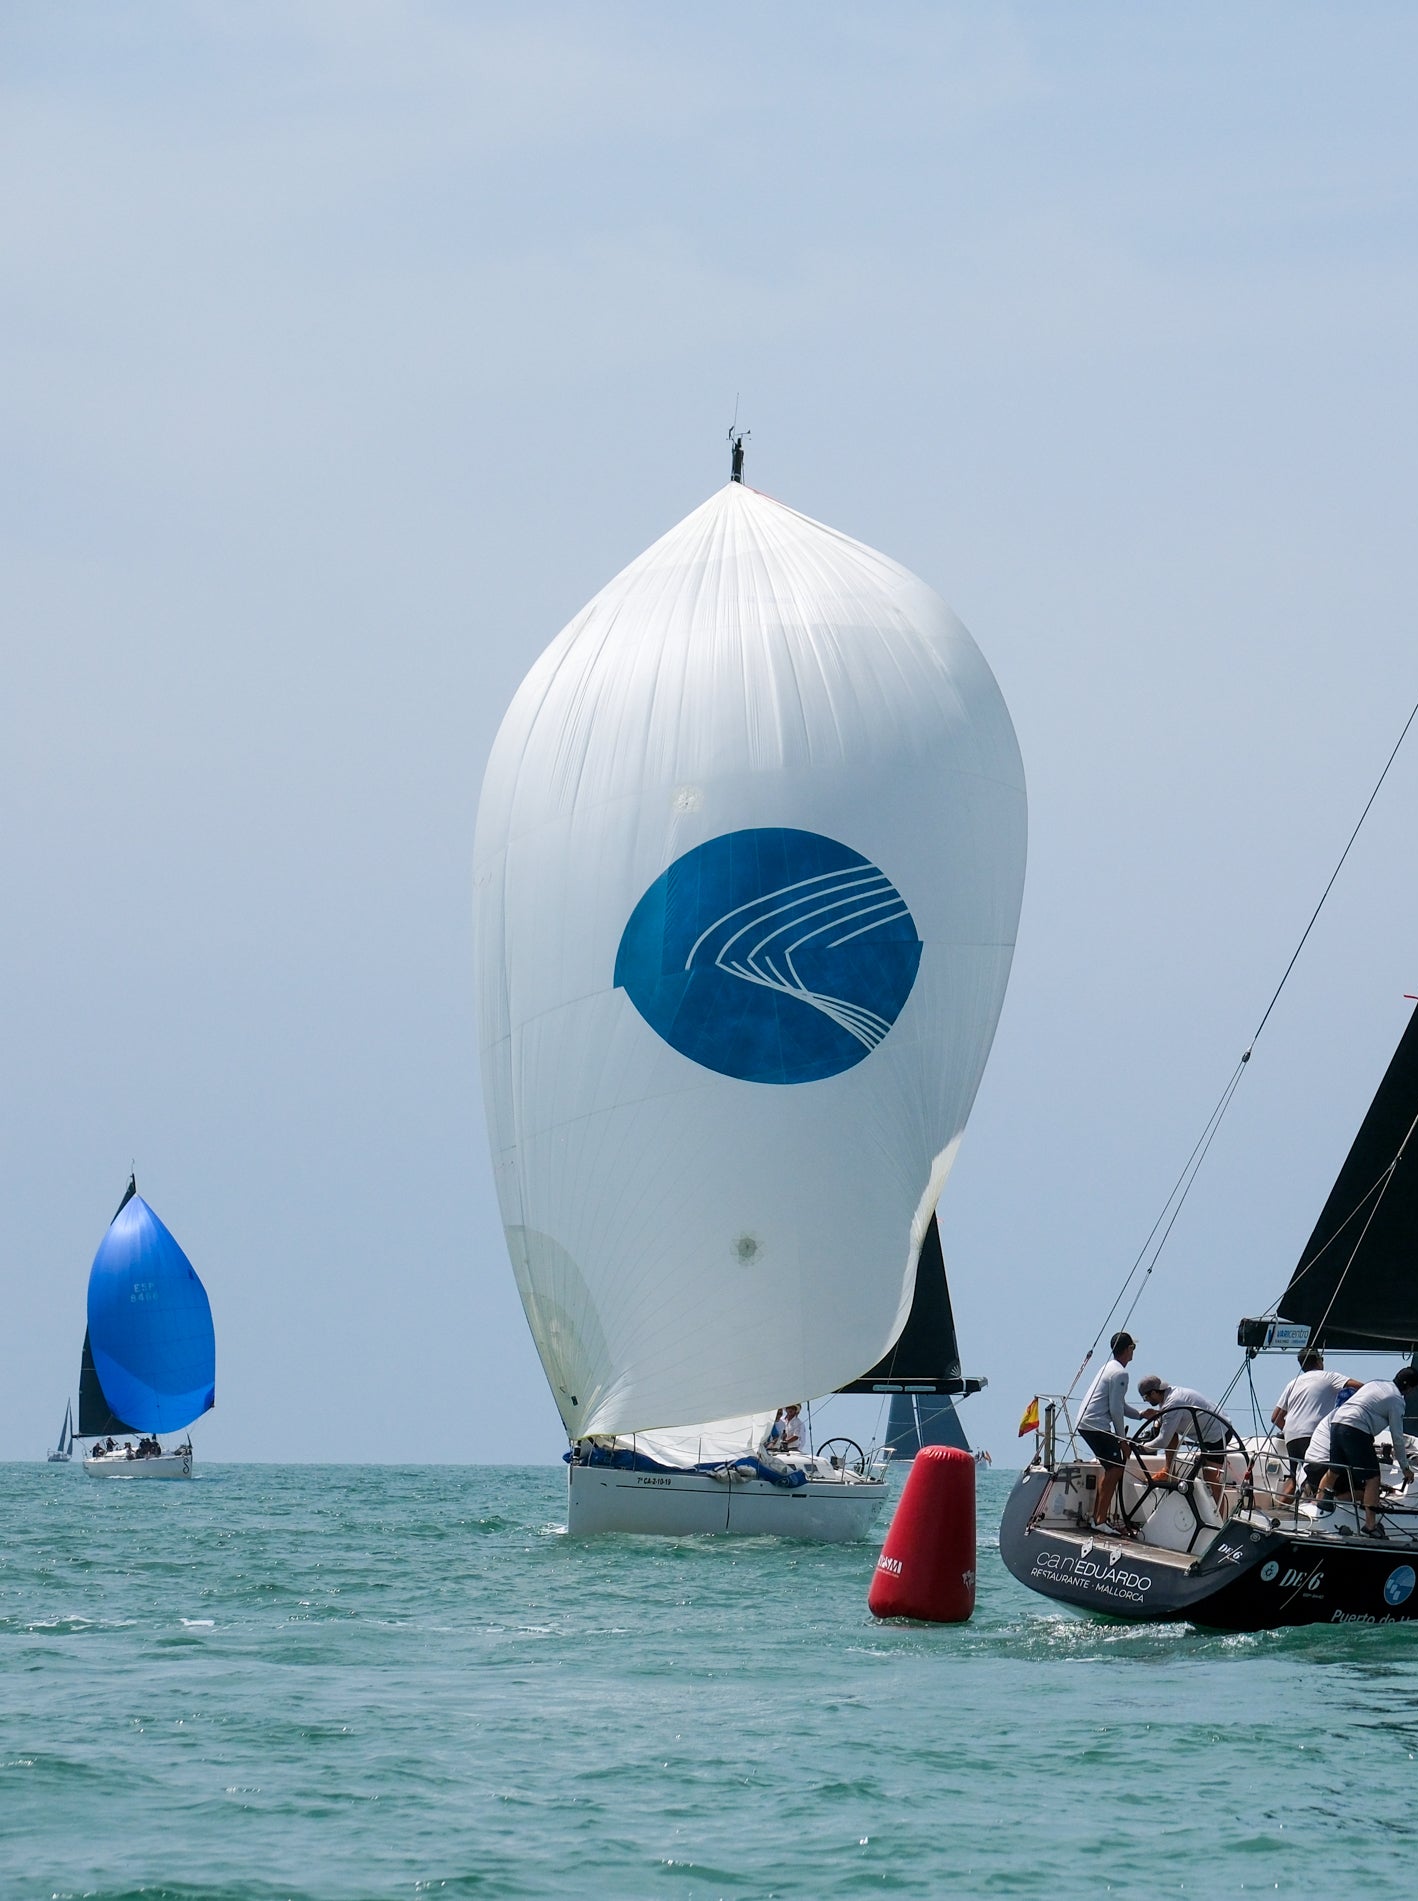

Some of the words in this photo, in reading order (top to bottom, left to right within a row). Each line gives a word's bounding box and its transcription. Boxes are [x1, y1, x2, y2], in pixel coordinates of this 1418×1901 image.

[133, 1282, 155, 1293] ESP
[1030, 1567, 1091, 1589] RESTAURANTE
[1095, 1583, 1144, 1603] MALLORCA
[1330, 1609, 1376, 1625] Puerto
